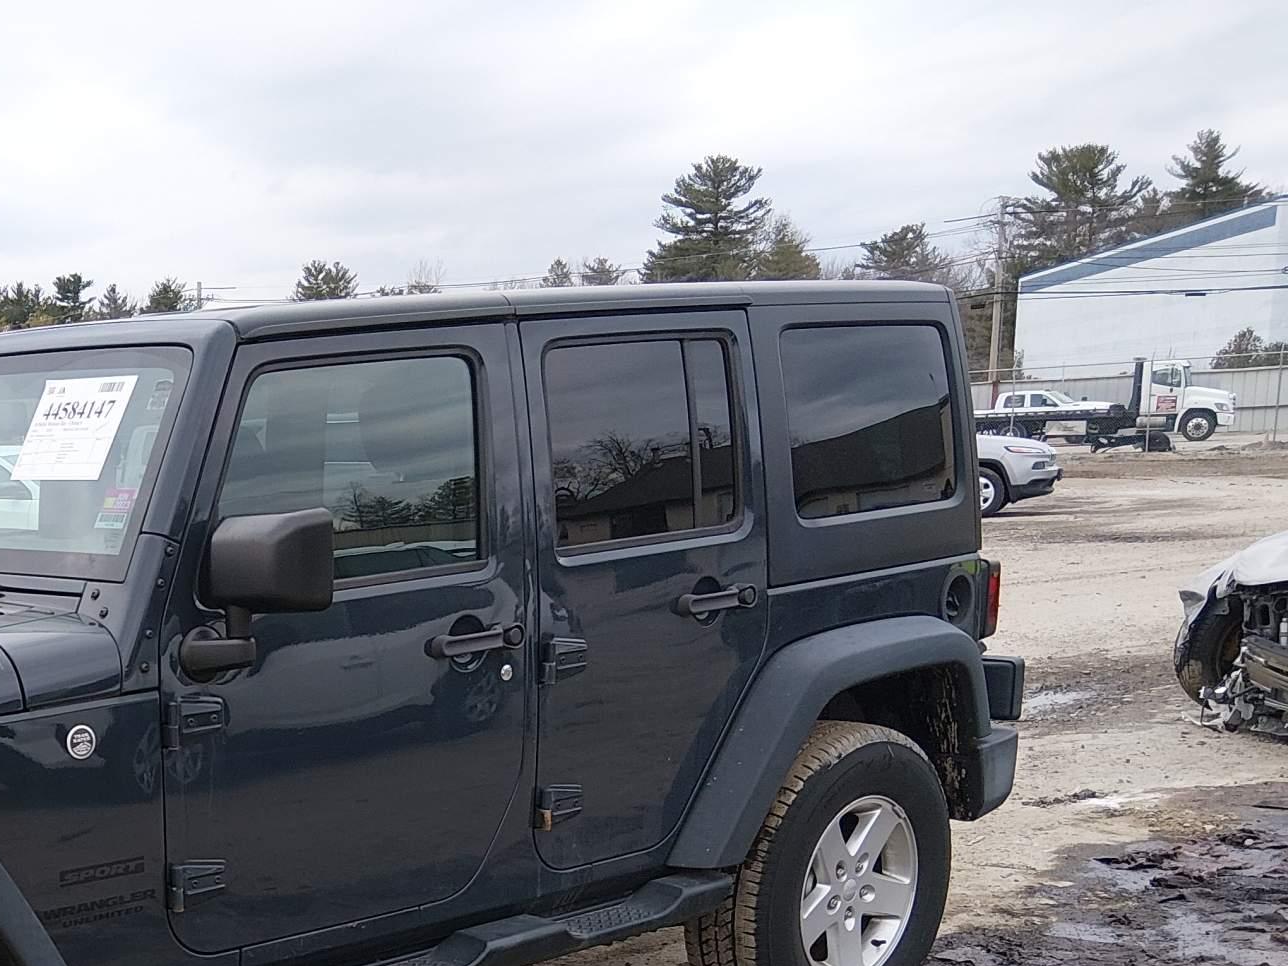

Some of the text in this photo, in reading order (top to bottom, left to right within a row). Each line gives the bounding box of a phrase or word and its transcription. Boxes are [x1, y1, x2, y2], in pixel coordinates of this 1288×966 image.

[43, 399, 116, 420] 44584147
[63, 863, 136, 881] SPORT
[43, 889, 156, 920] WRANGLER
[62, 905, 144, 928] UNLIMITED
